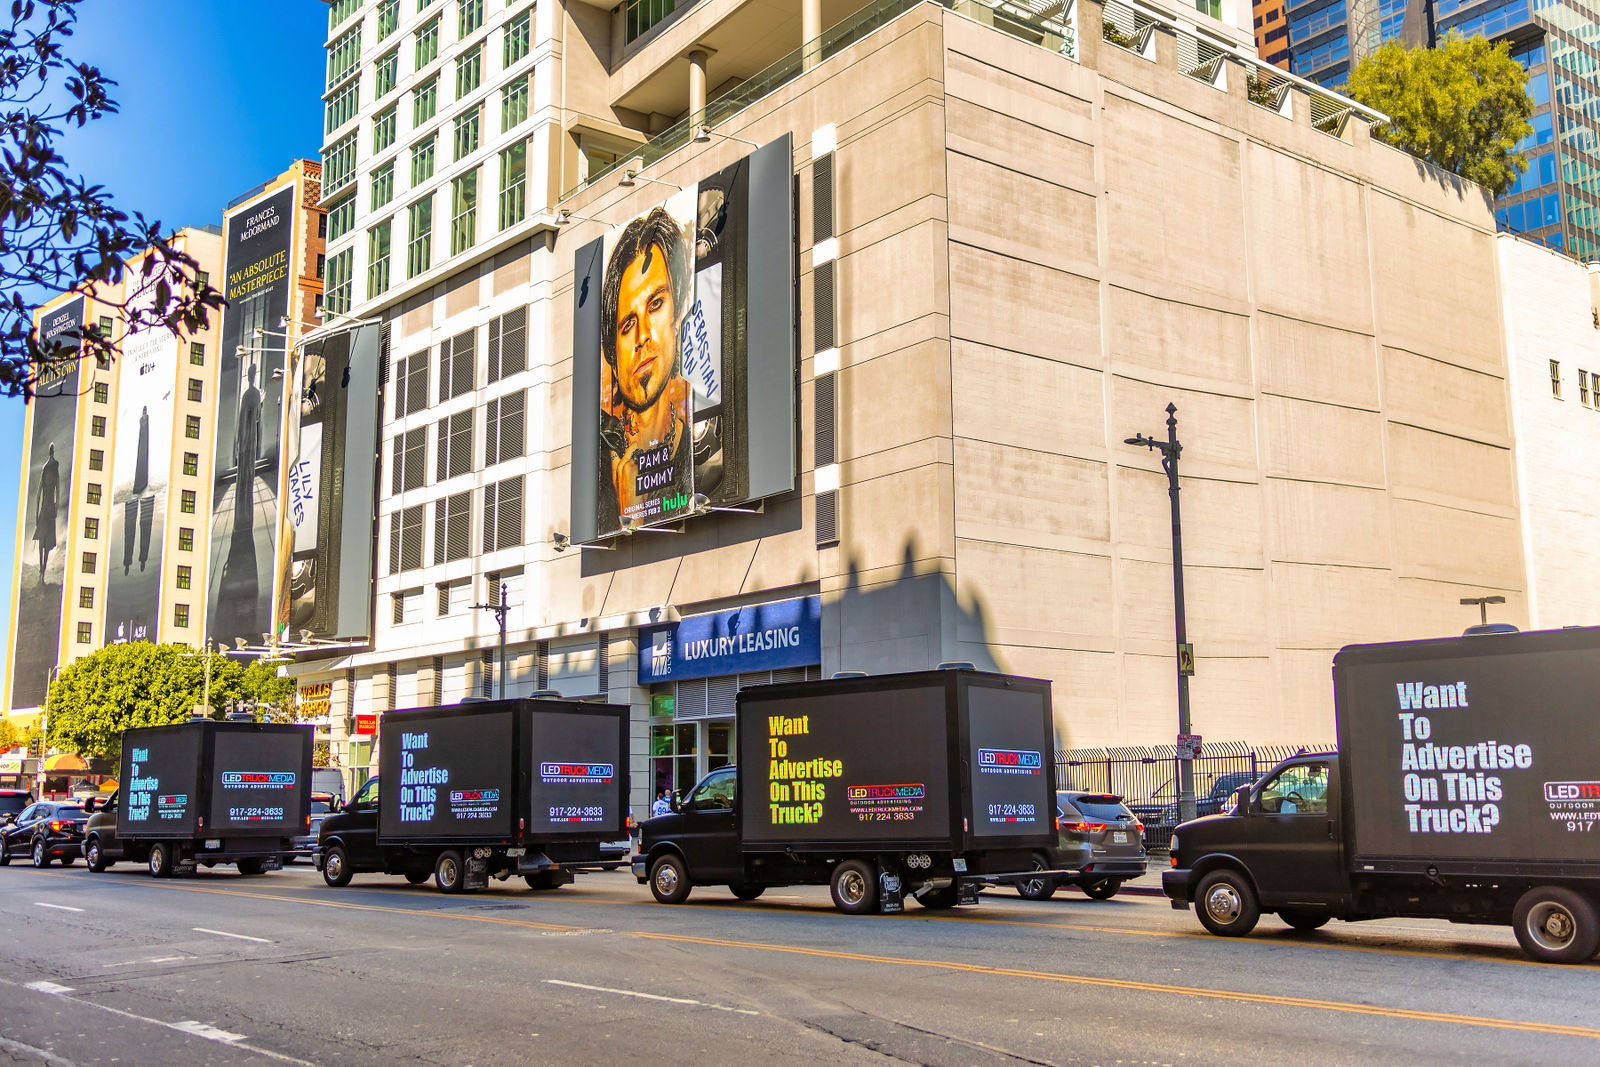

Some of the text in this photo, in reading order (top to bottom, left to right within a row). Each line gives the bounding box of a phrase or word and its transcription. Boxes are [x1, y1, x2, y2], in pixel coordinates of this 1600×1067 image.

[246, 206, 275, 228] FRANCES
[243, 250, 286, 279] ABSOLUTE
[682, 321, 697, 376] STAN
[692, 299, 718, 399] SEBASTIAN
[639, 447, 669, 471] PAM &
[299, 461, 313, 499] LILY
[636, 466, 674, 491] TOMMY
[289, 464, 305, 527] JAMES
[662, 491, 687, 511] hulu
[624, 497, 661, 514] ORIGINAL SERIES
[648, 507, 657, 516] FEB
[133, 624, 147, 639] A24
[684, 626, 800, 661] LUXURY LEASING
[300, 683, 331, 699] WELLS
[1396, 681, 1469, 710] Want
[300, 699, 330, 715] FARGO
[768, 715, 809, 736] Want
[1398, 713, 1431, 741] To
[401, 732, 429, 750] Want
[768, 738, 788, 758] To
[132, 748, 148, 762] Want
[401, 751, 414, 768] To
[980, 752, 1040, 766] LEDTRUCKMEDIA
[1401, 740, 1533, 771] Advertise
[131, 763, 139, 777] To
[400, 767, 448, 786] Advertise
[543, 765, 612, 776] LEDTRUCKMEDIA
[769, 757, 843, 780] Advertise
[130, 777, 158, 791] Advertise
[224, 774, 294, 783] LEDTRUCKMEDIA
[1404, 772, 1503, 802] On This
[137, 791, 151, 806] This
[400, 785, 437, 803] On This
[769, 780, 825, 802] On This
[850, 786, 923, 798] LEDTRUCKMEDIA
[128, 806, 150, 821] Truck?
[229, 808, 284, 816] 917-224-3633
[400, 804, 434, 822] Truck?
[549, 807, 603, 817] 917-224-3633
[769, 802, 823, 824] Truck?
[858, 812, 915, 821] 917 224 3633
[988, 804, 1035, 816] 917-224-3633
[1404, 803, 1500, 833] Truck?
[1567, 821, 1594, 832] 917
